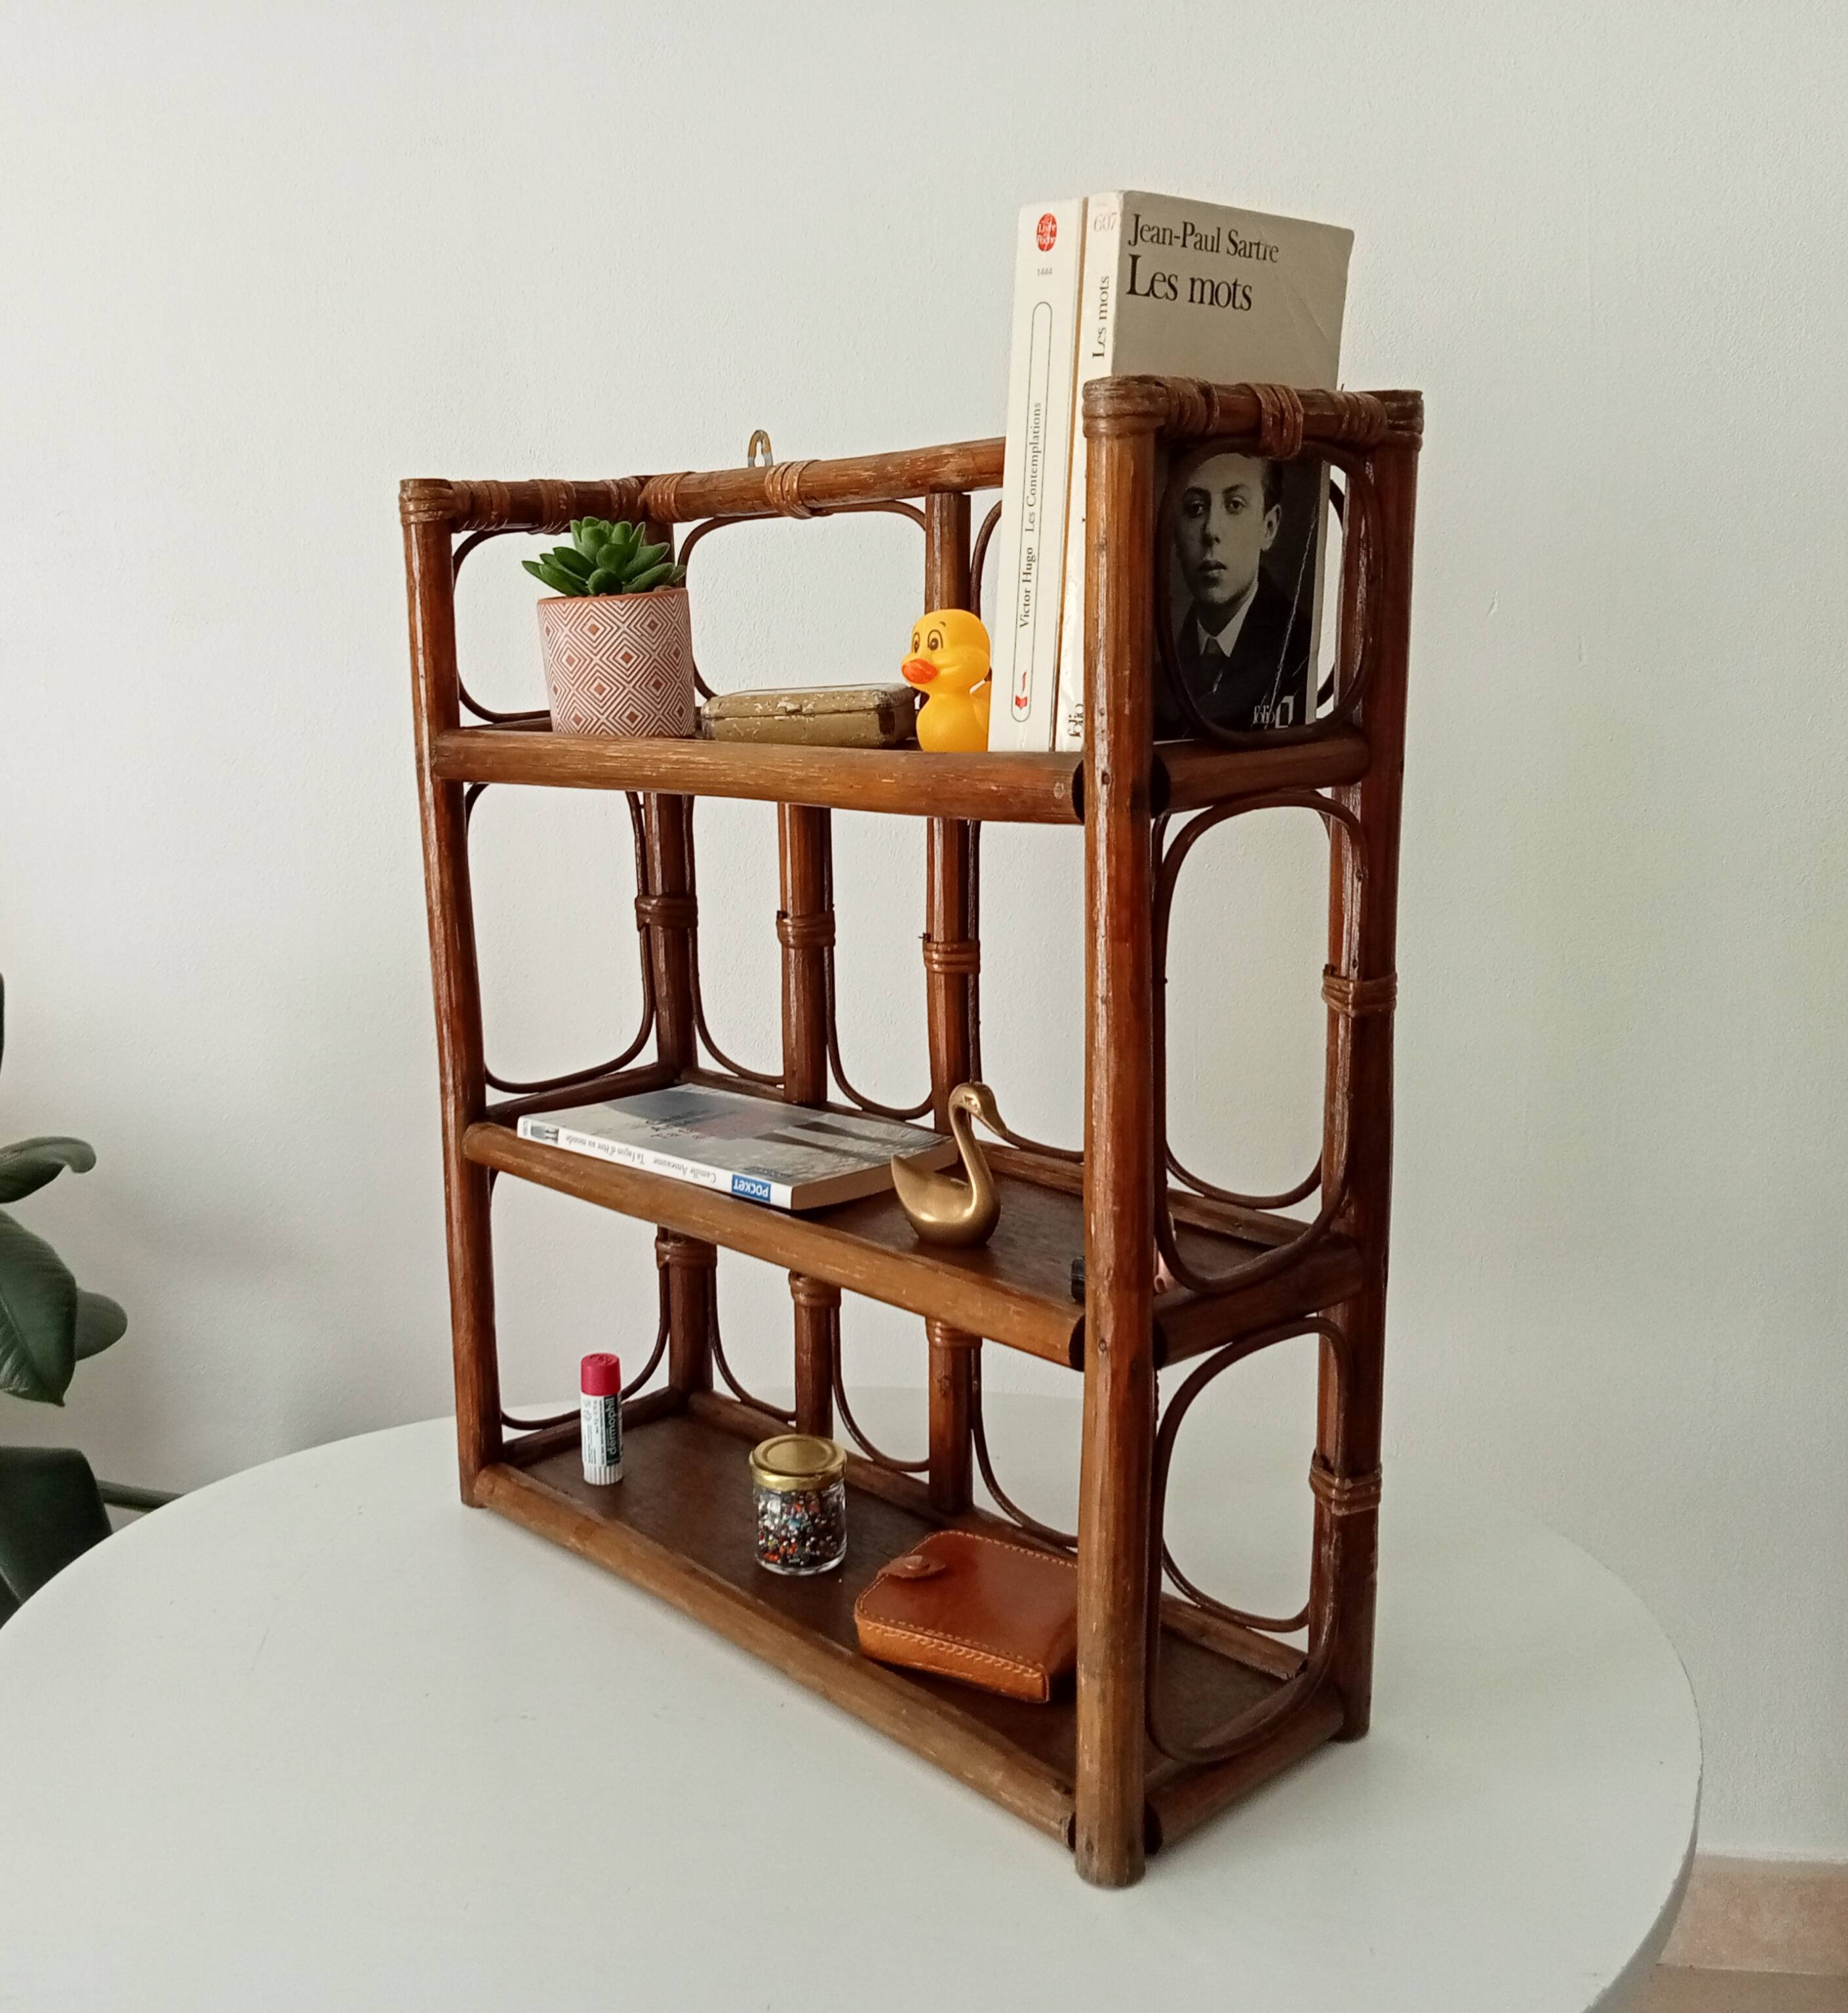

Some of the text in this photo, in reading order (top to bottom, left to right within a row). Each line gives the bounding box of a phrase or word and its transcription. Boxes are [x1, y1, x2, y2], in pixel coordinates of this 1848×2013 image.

[1093, 212, 1118, 232] 607
[1128, 214, 1280, 263] Jean-Paul Sartre
[1126, 254, 1253, 312] Les mots
[1092, 275, 1110, 359] Les mots
[1019, 402, 1042, 629] Victor Hugo Les Contemplations
[689, 1166, 717, 1184] Camille
